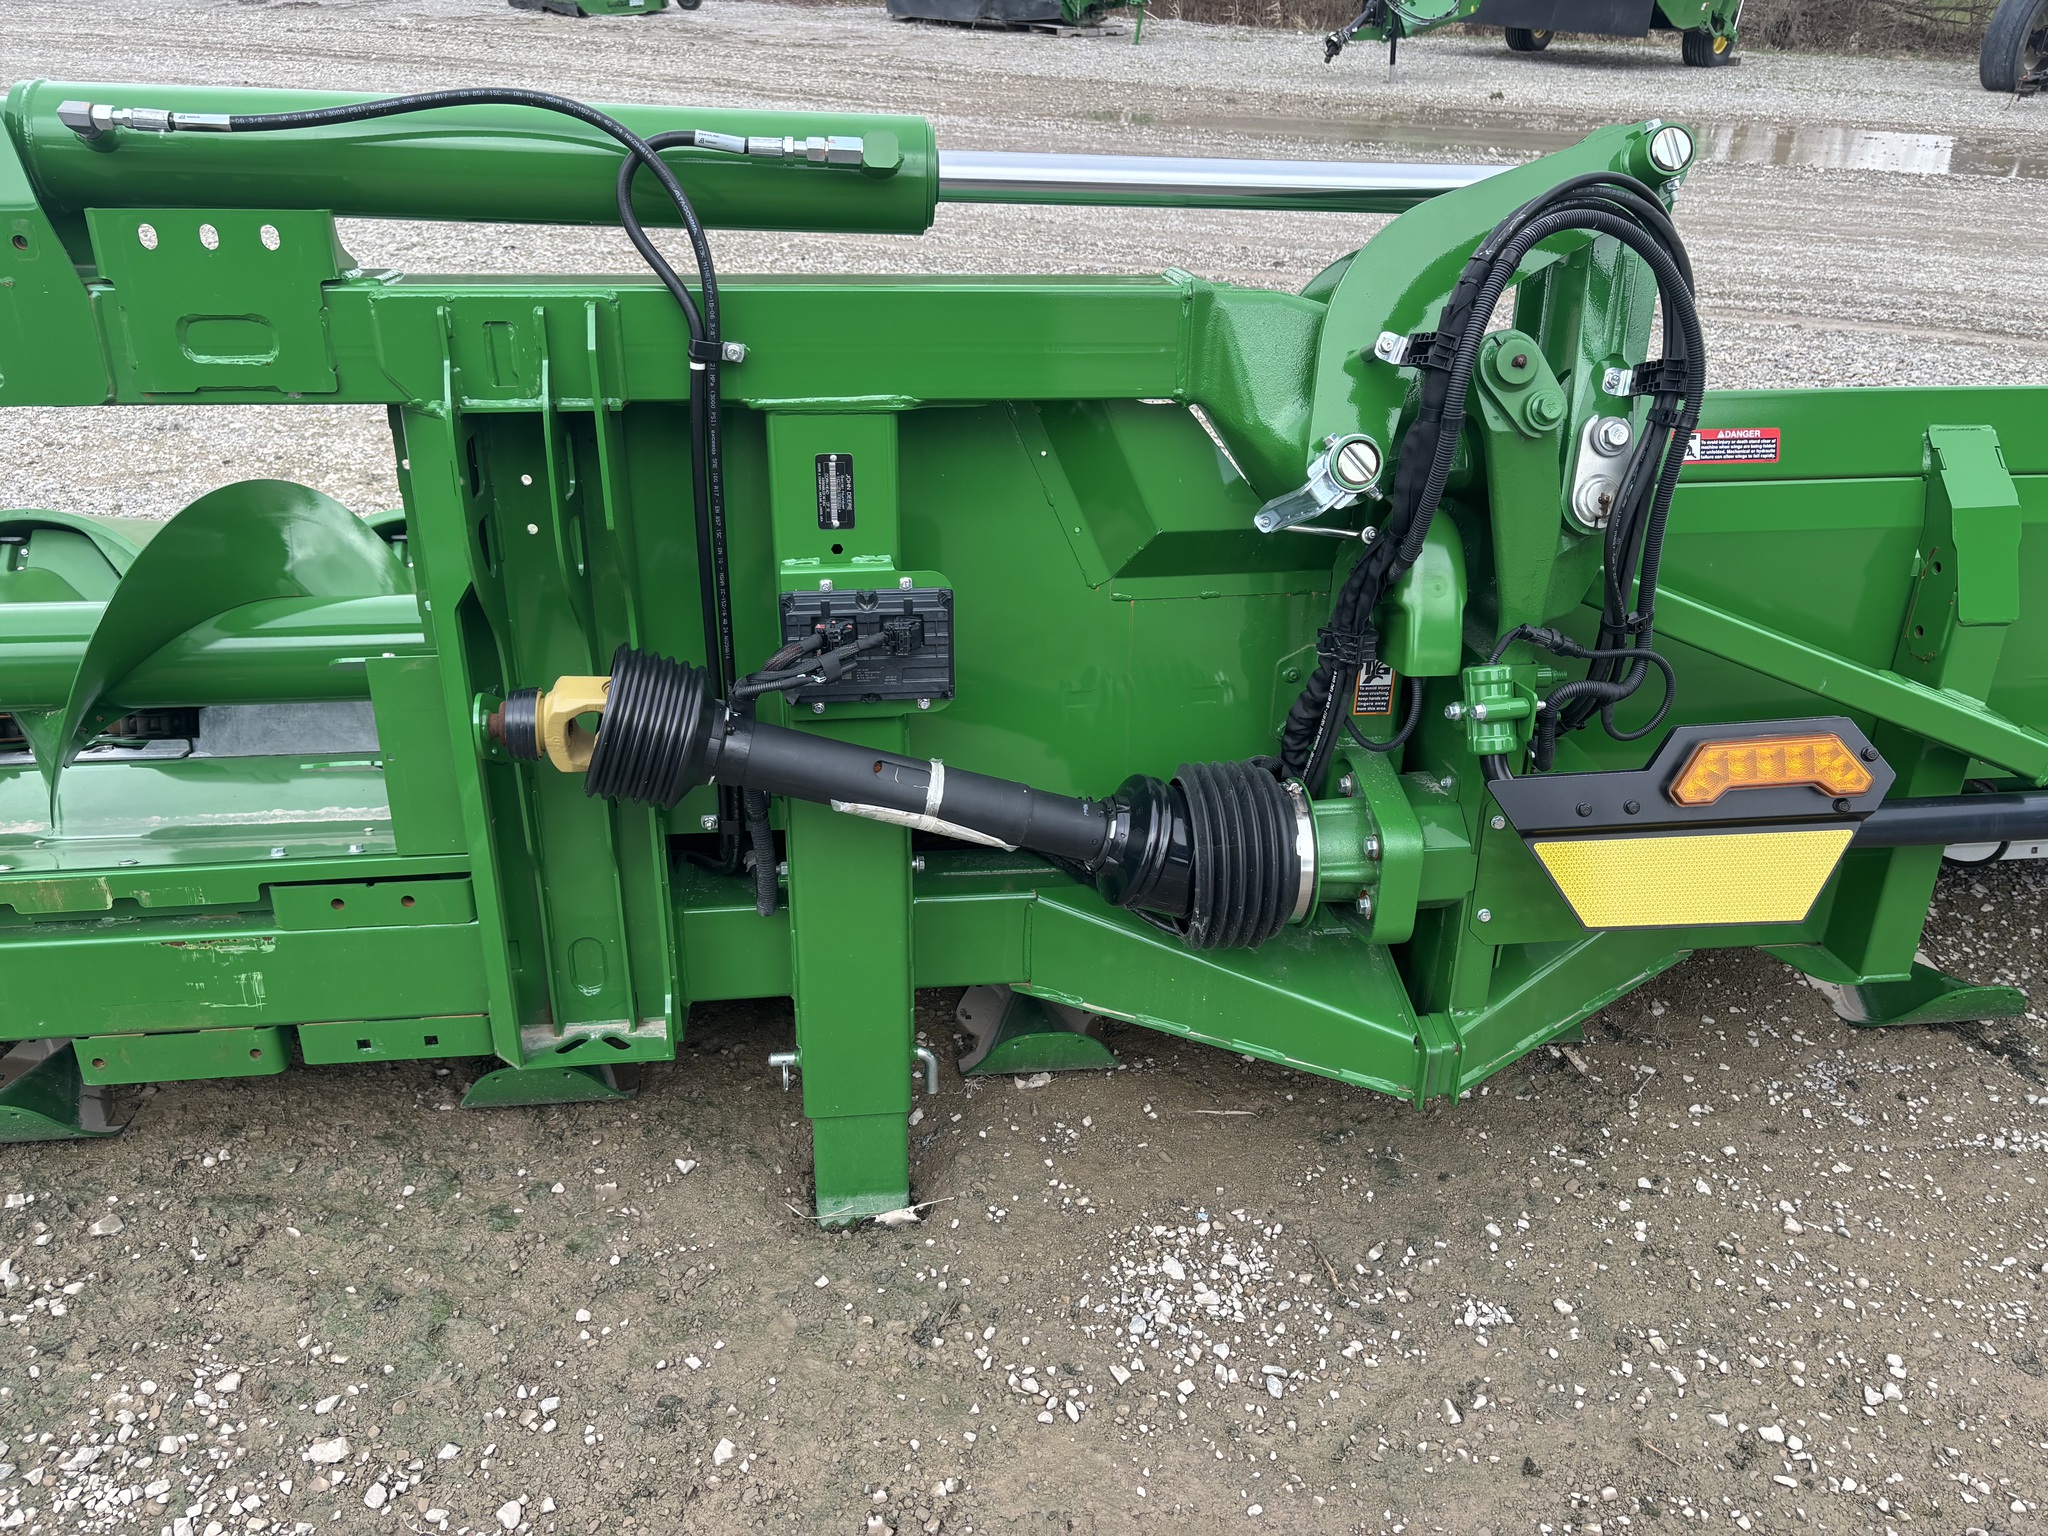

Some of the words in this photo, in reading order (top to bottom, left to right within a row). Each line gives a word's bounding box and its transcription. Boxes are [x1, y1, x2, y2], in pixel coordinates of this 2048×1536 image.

[305, 112, 320, 120] MPa
[324, 108, 346, 118] (3000
[348, 105, 366, 114] PSI)
[370, 100, 399, 110] exceeds
[402, 97, 415, 105] SAE
[545, 96, 563, 105] MSHA
[614, 125, 623, 134] 24
[673, 188, 698, 236] ALFAGOMMA
[1725, 430, 1761, 438] DANGER
[714, 505, 720, 514] EN
